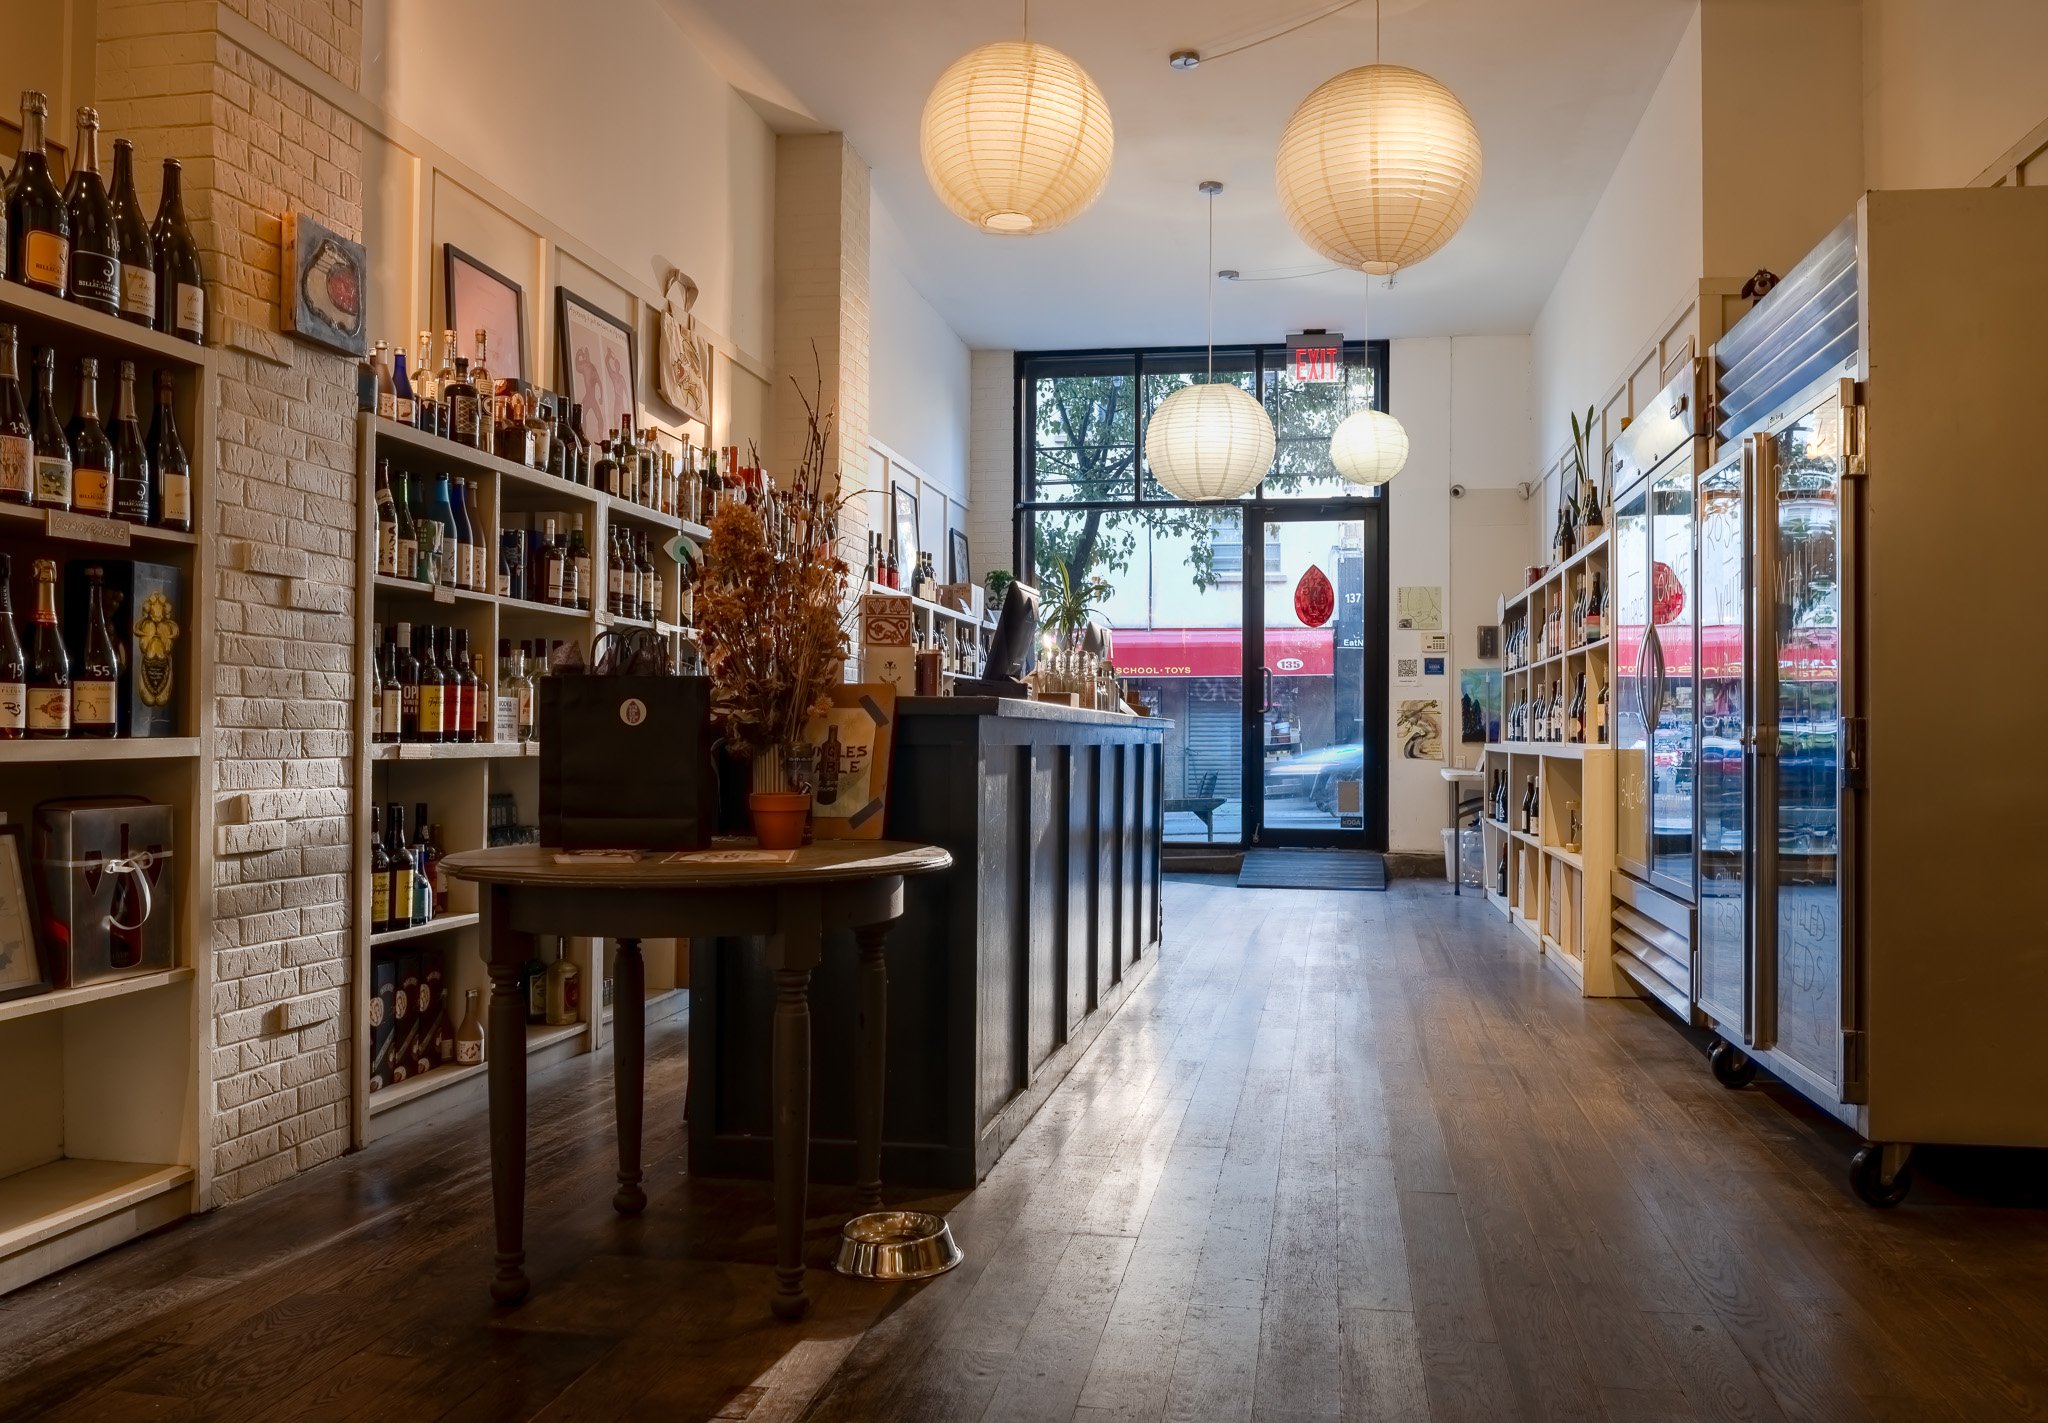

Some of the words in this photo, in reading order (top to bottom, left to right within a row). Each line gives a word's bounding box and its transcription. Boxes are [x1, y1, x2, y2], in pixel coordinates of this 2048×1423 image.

[1295, 348, 1338, 381] EXIT
[10, 422, 29, 435] 78
[1345, 592, 1361, 604] 137
[93, 664, 110, 676] 55
[1115, 666, 1159, 675] SCHOOL
[1165, 666, 1192, 674] TOYS
[1280, 661, 1300, 669] 135
[814, 760, 860, 774] ABLE
